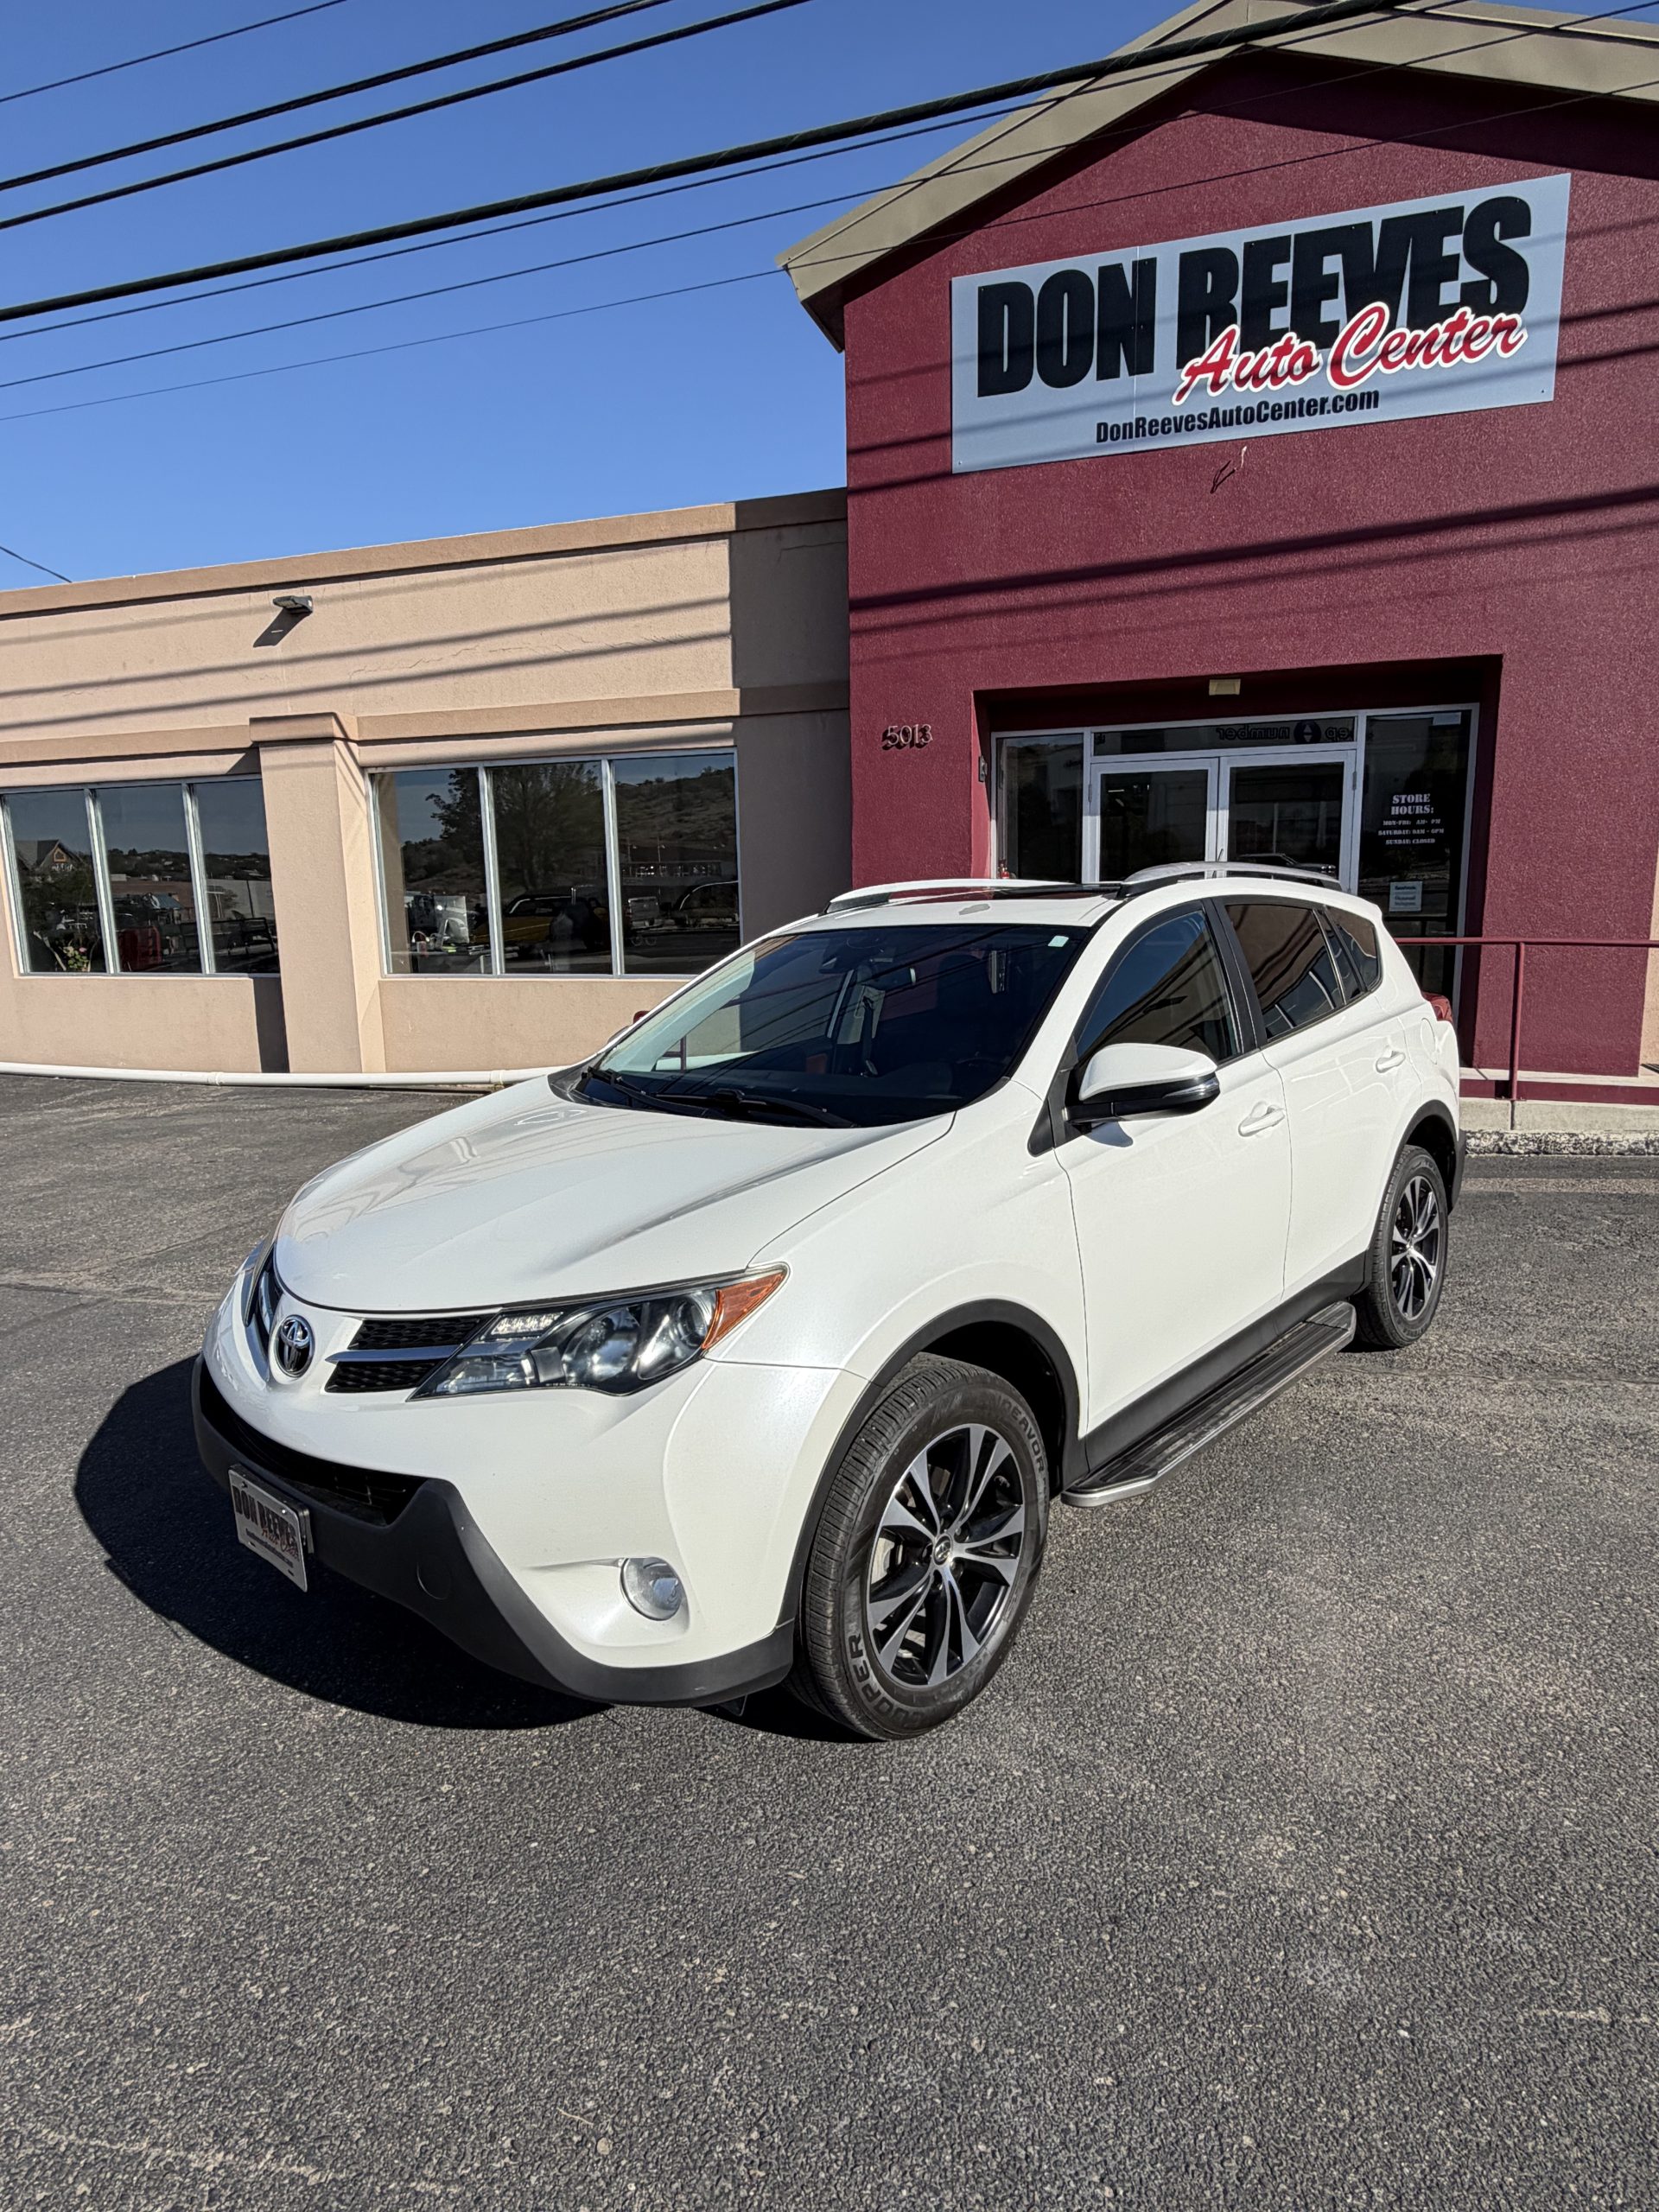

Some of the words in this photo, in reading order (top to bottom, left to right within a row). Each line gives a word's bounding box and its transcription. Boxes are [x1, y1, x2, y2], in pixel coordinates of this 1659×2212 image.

[977, 257, 1157, 397] DON
[1176, 196, 1532, 370] REEVES
[1173, 325, 1320, 404] Auto
[1328, 302, 1527, 389] Center
[1096, 389, 1380, 443] DonReevesAutoCenter.com
[884, 723, 933, 747] 5013
[1390, 804, 1434, 815] HOURS:
[1392, 793, 1431, 804] STORE
